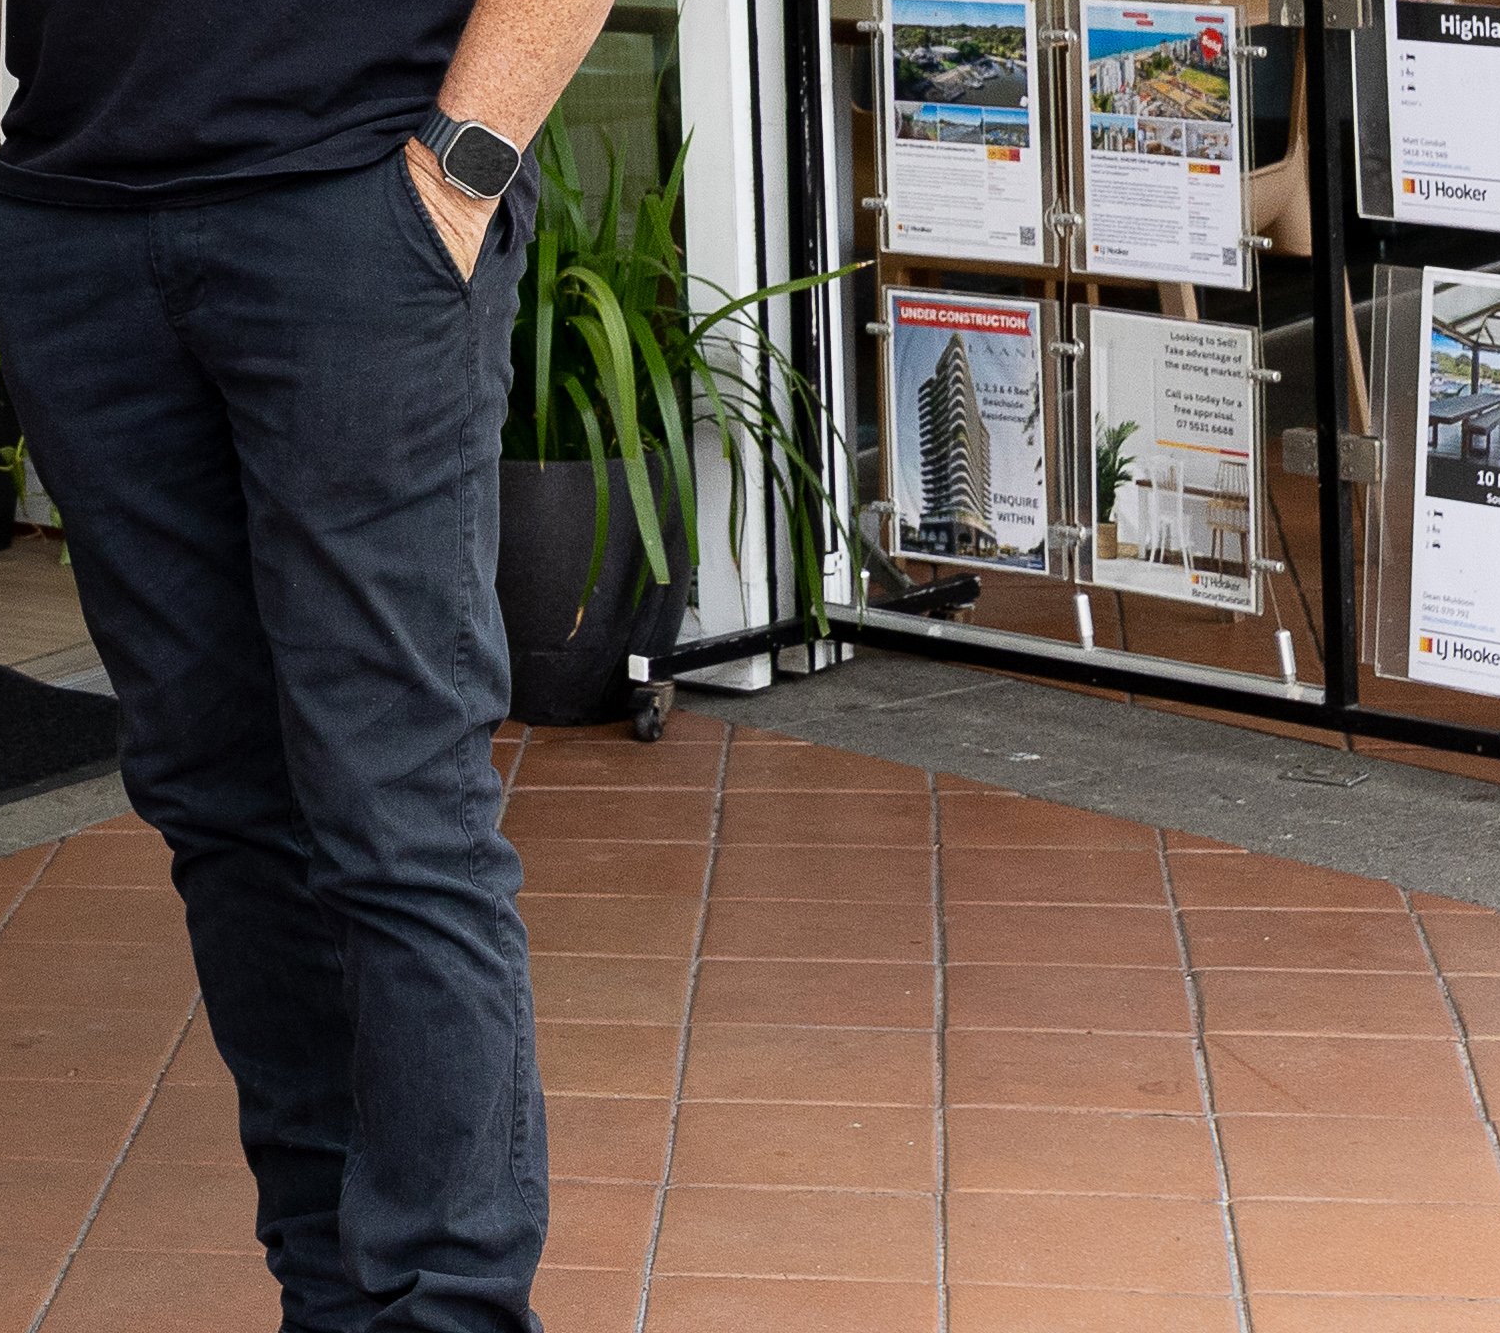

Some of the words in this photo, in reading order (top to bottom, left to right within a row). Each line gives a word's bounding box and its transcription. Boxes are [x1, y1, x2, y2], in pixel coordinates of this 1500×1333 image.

[1419, 180, 1430, 199] LJ
[1435, 181, 1487, 201] Hooker
[901, 307, 936, 321] UNDER
[938, 311, 1026, 329] CONSTRUCTION
[1170, 333, 1203, 346] Looking
[1206, 336, 1215, 345] to
[1217, 337, 1237, 347] Sell?
[1165, 346, 1184, 356] Take
[1186, 348, 1230, 364] advantage
[1233, 354, 1242, 364] of
[1165, 360, 1179, 370] the
[1182, 363, 1208, 376] strong
[1211, 367, 1244, 378] market.
[1166, 389, 1184, 400] Call
[1186, 393, 1193, 401] us
[1195, 394, 1220, 407] today
[1223, 396, 1235, 406] for
[1174, 404, 1191, 416] free
[1193, 408, 1235, 422] appraisal.
[1477, 470, 1494, 486] 10
[994, 494, 1039, 508] ENQUIRE
[997, 513, 1035, 525] WITHIN
[1437, 639, 1448, 659] LJ
